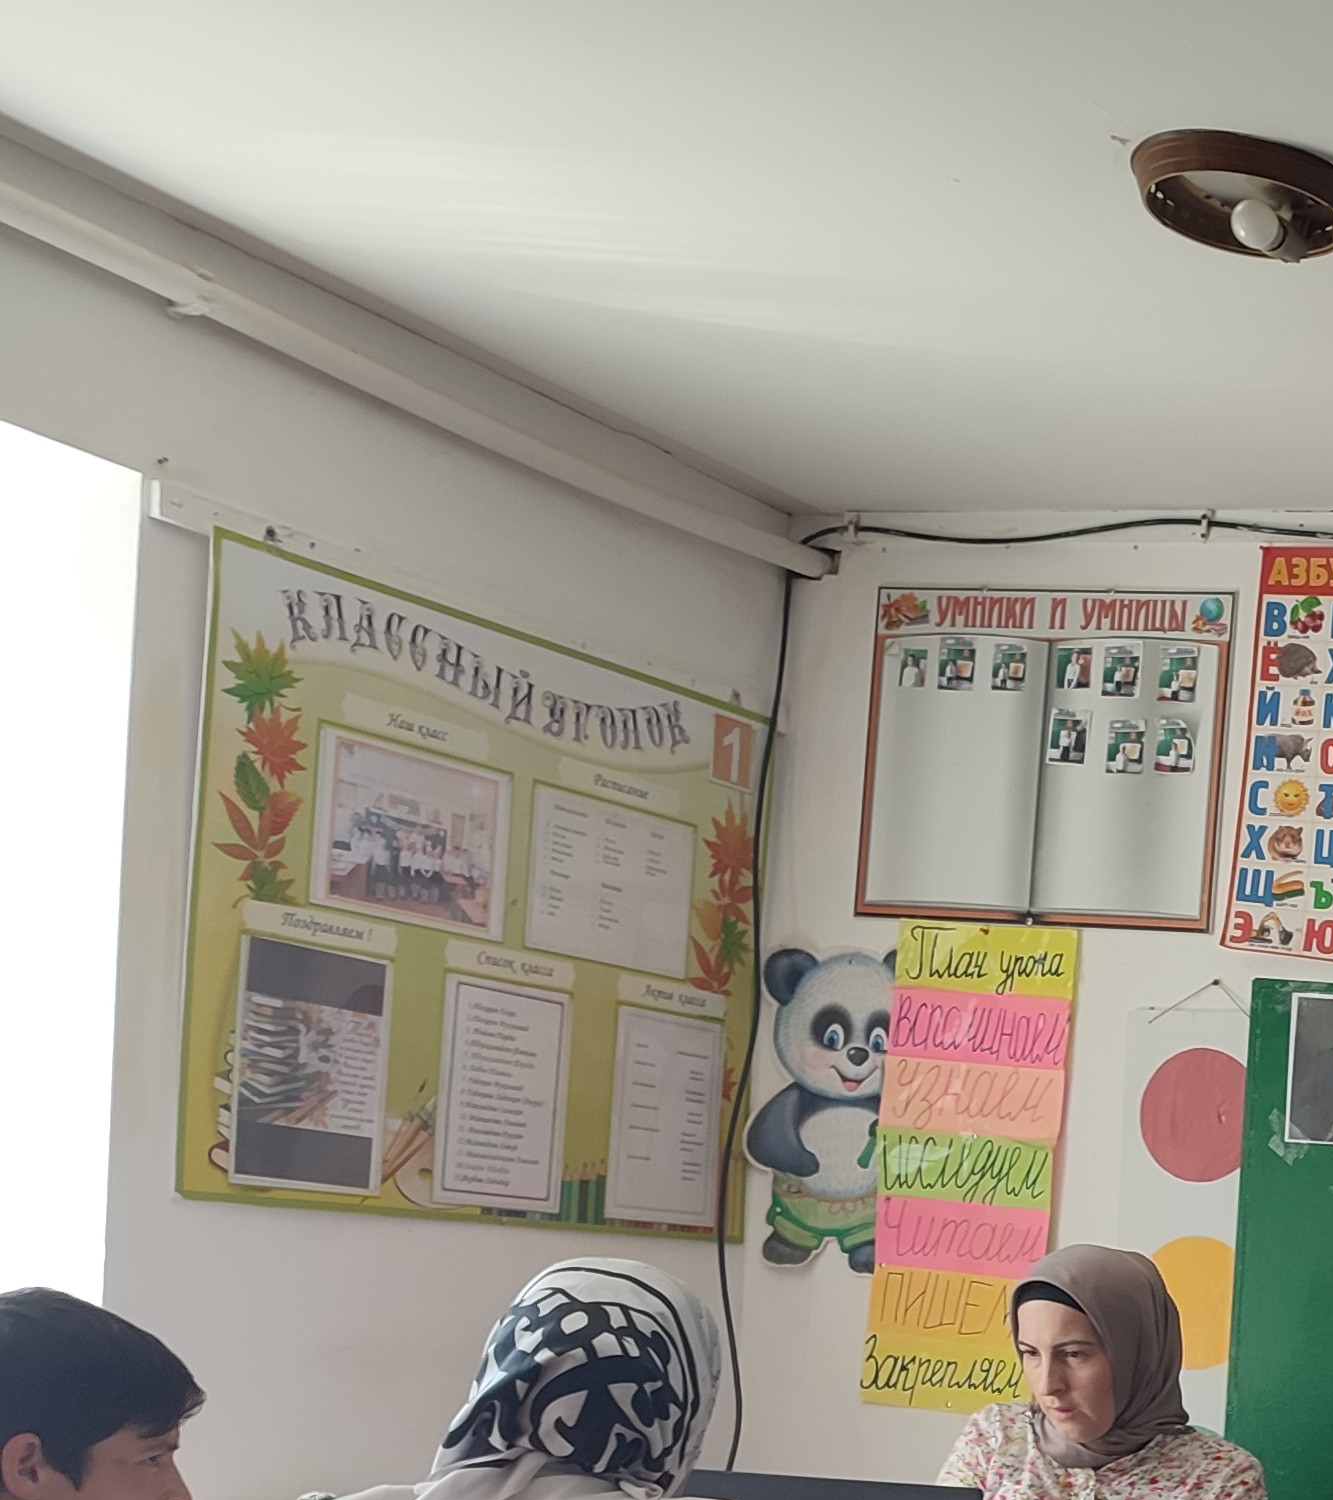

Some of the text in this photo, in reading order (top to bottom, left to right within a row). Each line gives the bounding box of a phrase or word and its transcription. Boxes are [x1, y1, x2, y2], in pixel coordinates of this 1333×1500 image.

[935, 595, 1187, 634] УМНИКИ И УМНИЦЫ
[1263, 601, 1287, 637] В
[279, 589, 690, 755] КЛАССНЫЙ УГОЛОК
[1255, 686, 1281, 726] Й
[722, 727, 742, 783] 1
[1248, 780, 1269, 816] С
[1240, 823, 1269, 860] Х
[1236, 867, 1275, 908] Щ
[1309, 880, 1333, 910] Ъ
[905, 925, 1065, 996] План урока
[860, 1334, 1025, 1406] Закрепляем
